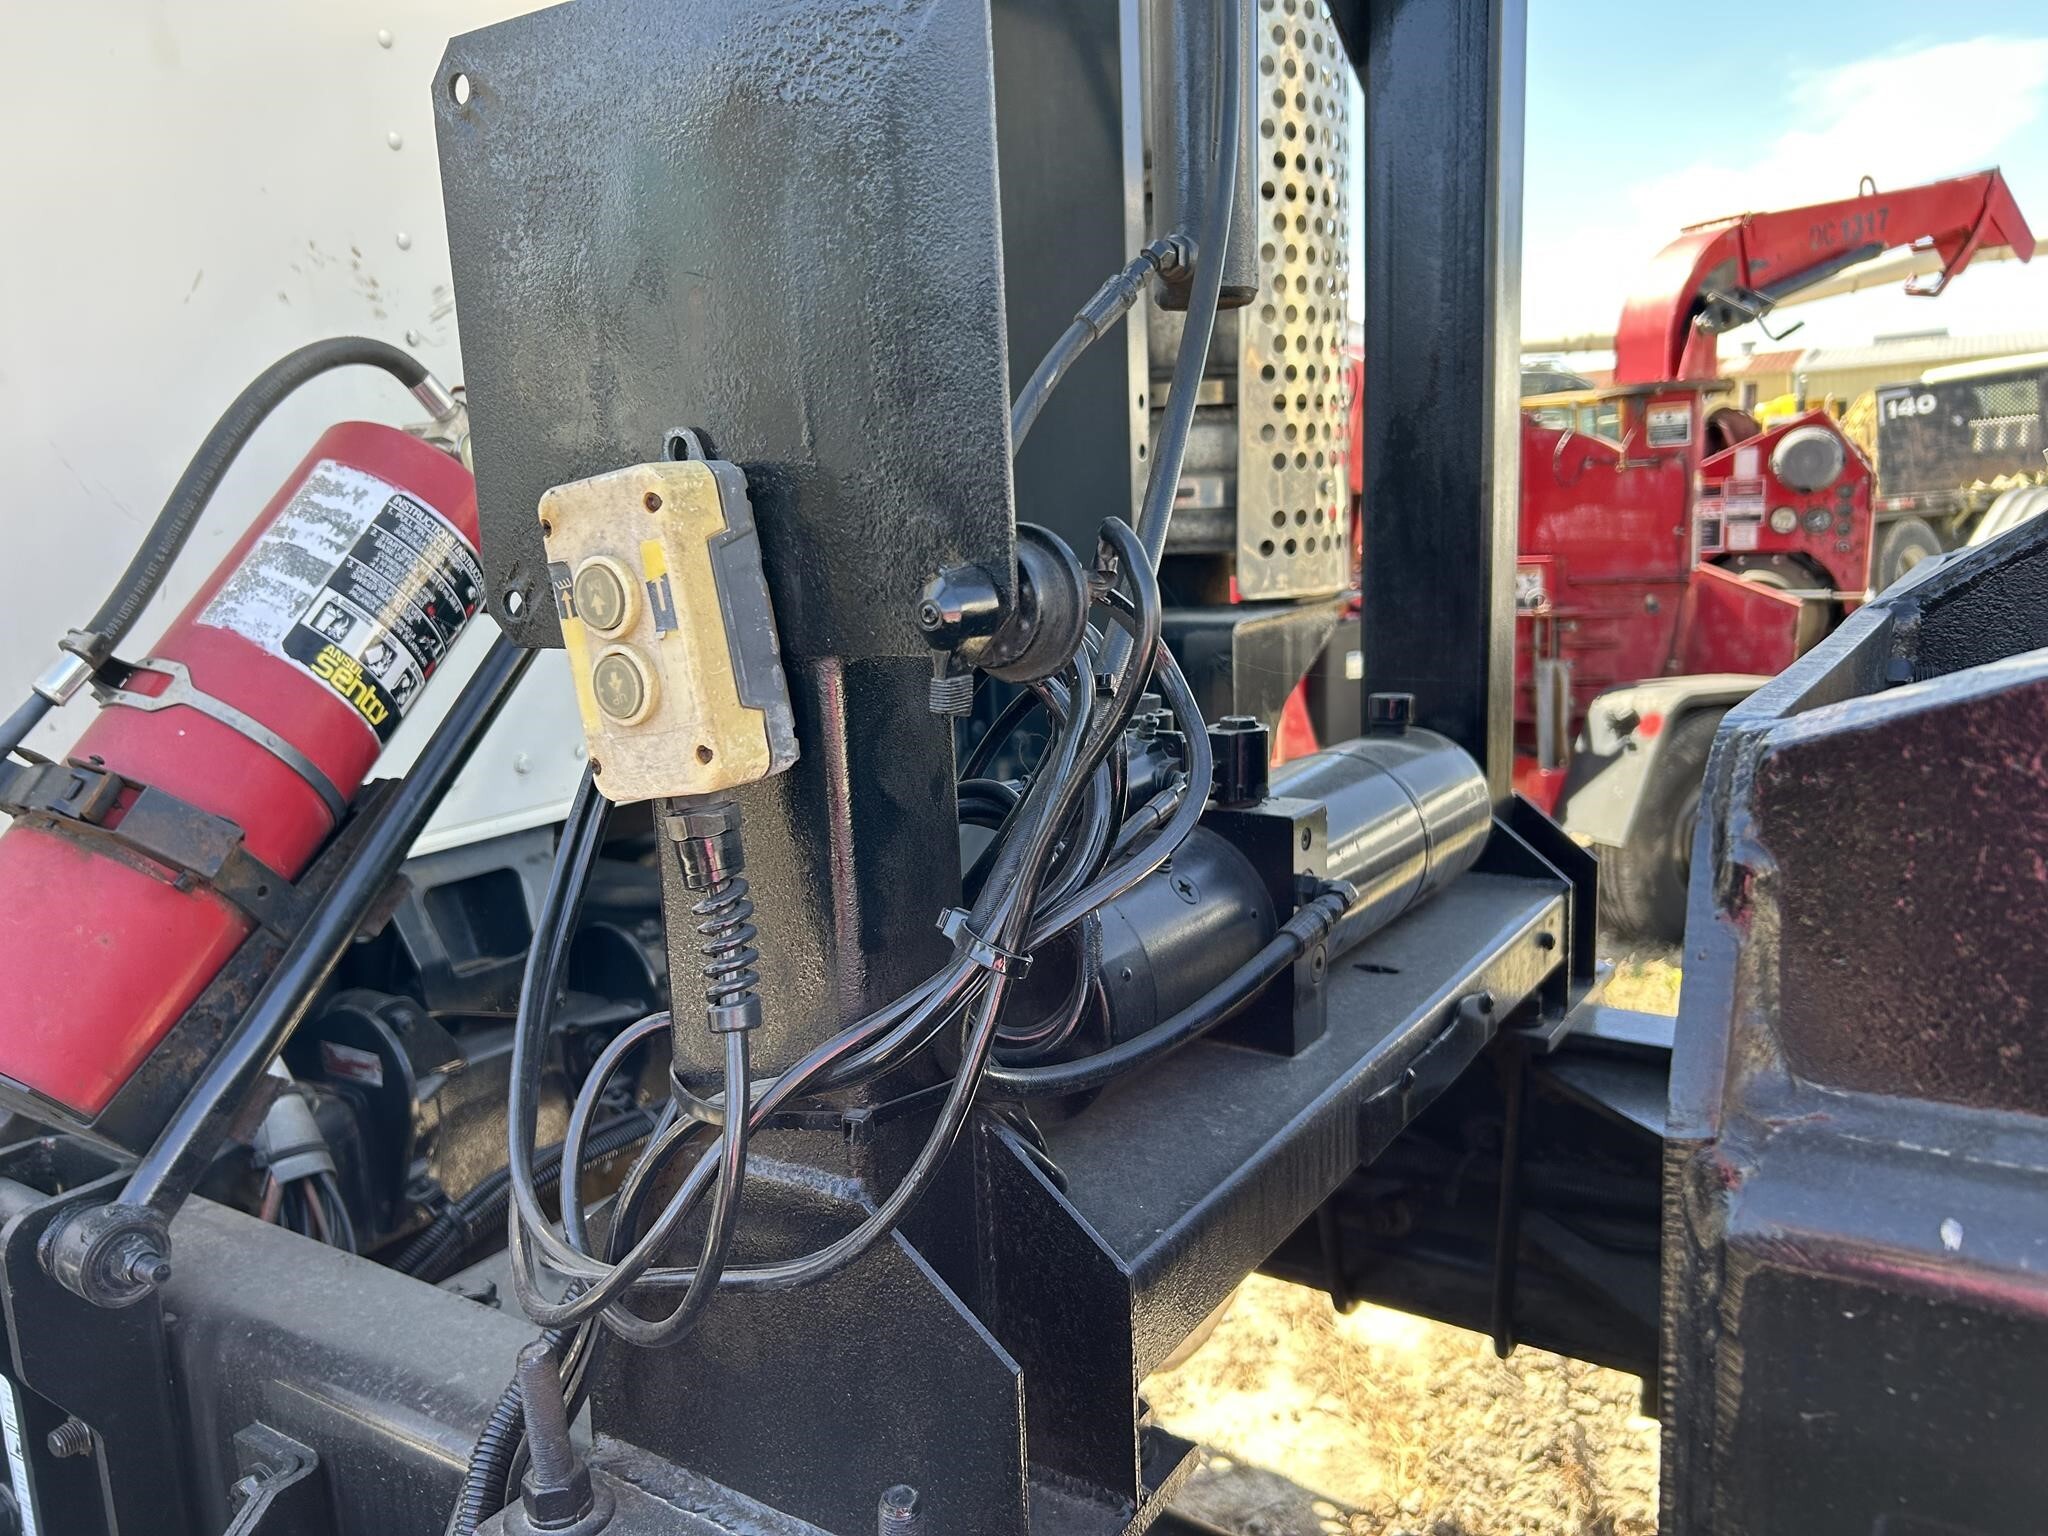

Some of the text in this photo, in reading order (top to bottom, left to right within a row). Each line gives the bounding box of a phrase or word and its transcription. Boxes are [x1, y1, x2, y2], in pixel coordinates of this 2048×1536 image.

[1886, 393, 1937, 420] 140
[392, 494, 456, 547] INSTRUCTIONS
[323, 644, 364, 680] ANSUL
[611, 693, 628, 705] UP
